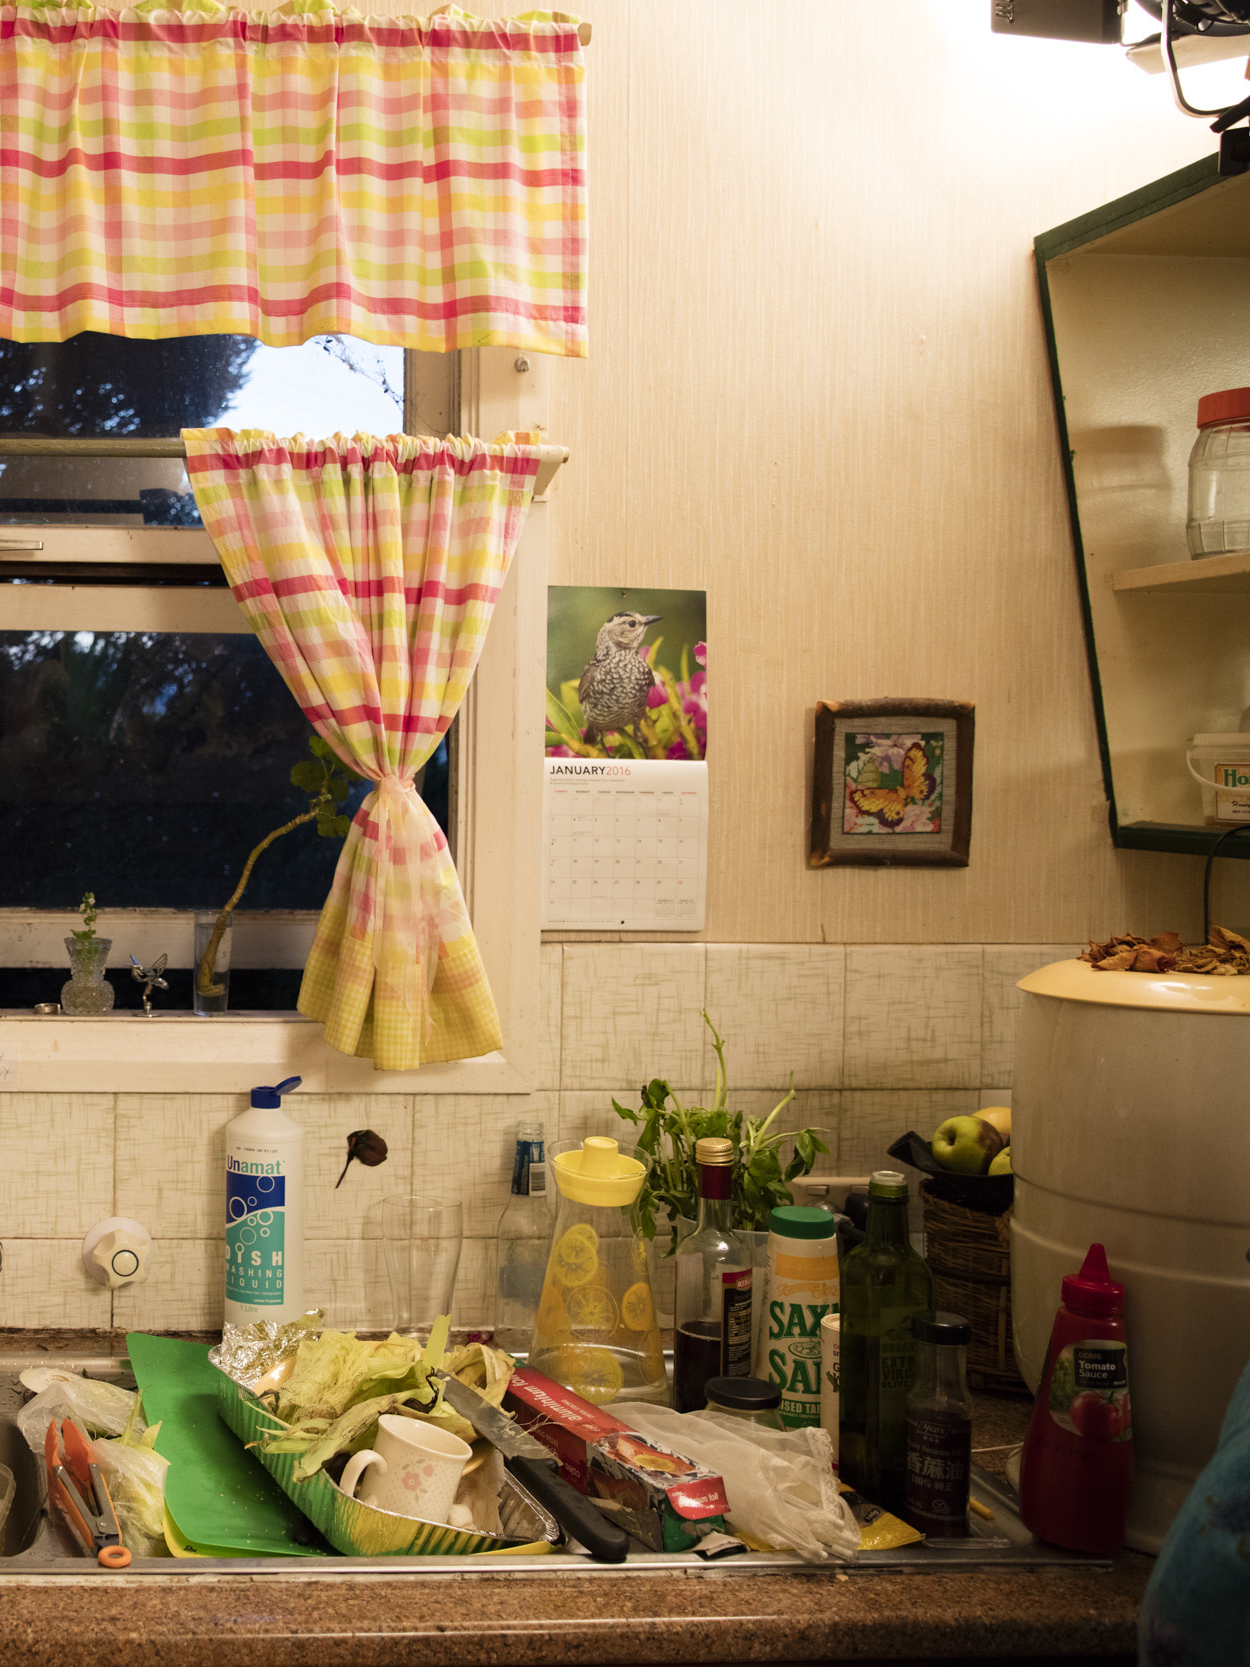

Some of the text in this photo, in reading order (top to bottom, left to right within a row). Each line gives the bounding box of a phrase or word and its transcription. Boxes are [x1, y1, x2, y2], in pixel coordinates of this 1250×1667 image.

[550, 766, 631, 776] JANUARY 2016
[228, 1154, 281, 1175] Unamat
[226, 1243, 282, 1267] DISH
[226, 1276, 282, 1289] IQUID
[245, 1305, 258, 1313] Litre
[1078, 1360, 1116, 1371] Tomato
[1079, 1369, 1108, 1379] Sauce
[524, 1385, 583, 1421] aluminium
[561, 1398, 595, 1419] EXTRA STRONG
[781, 1400, 803, 1413] ISED
[708, 1492, 719, 1501] foil
